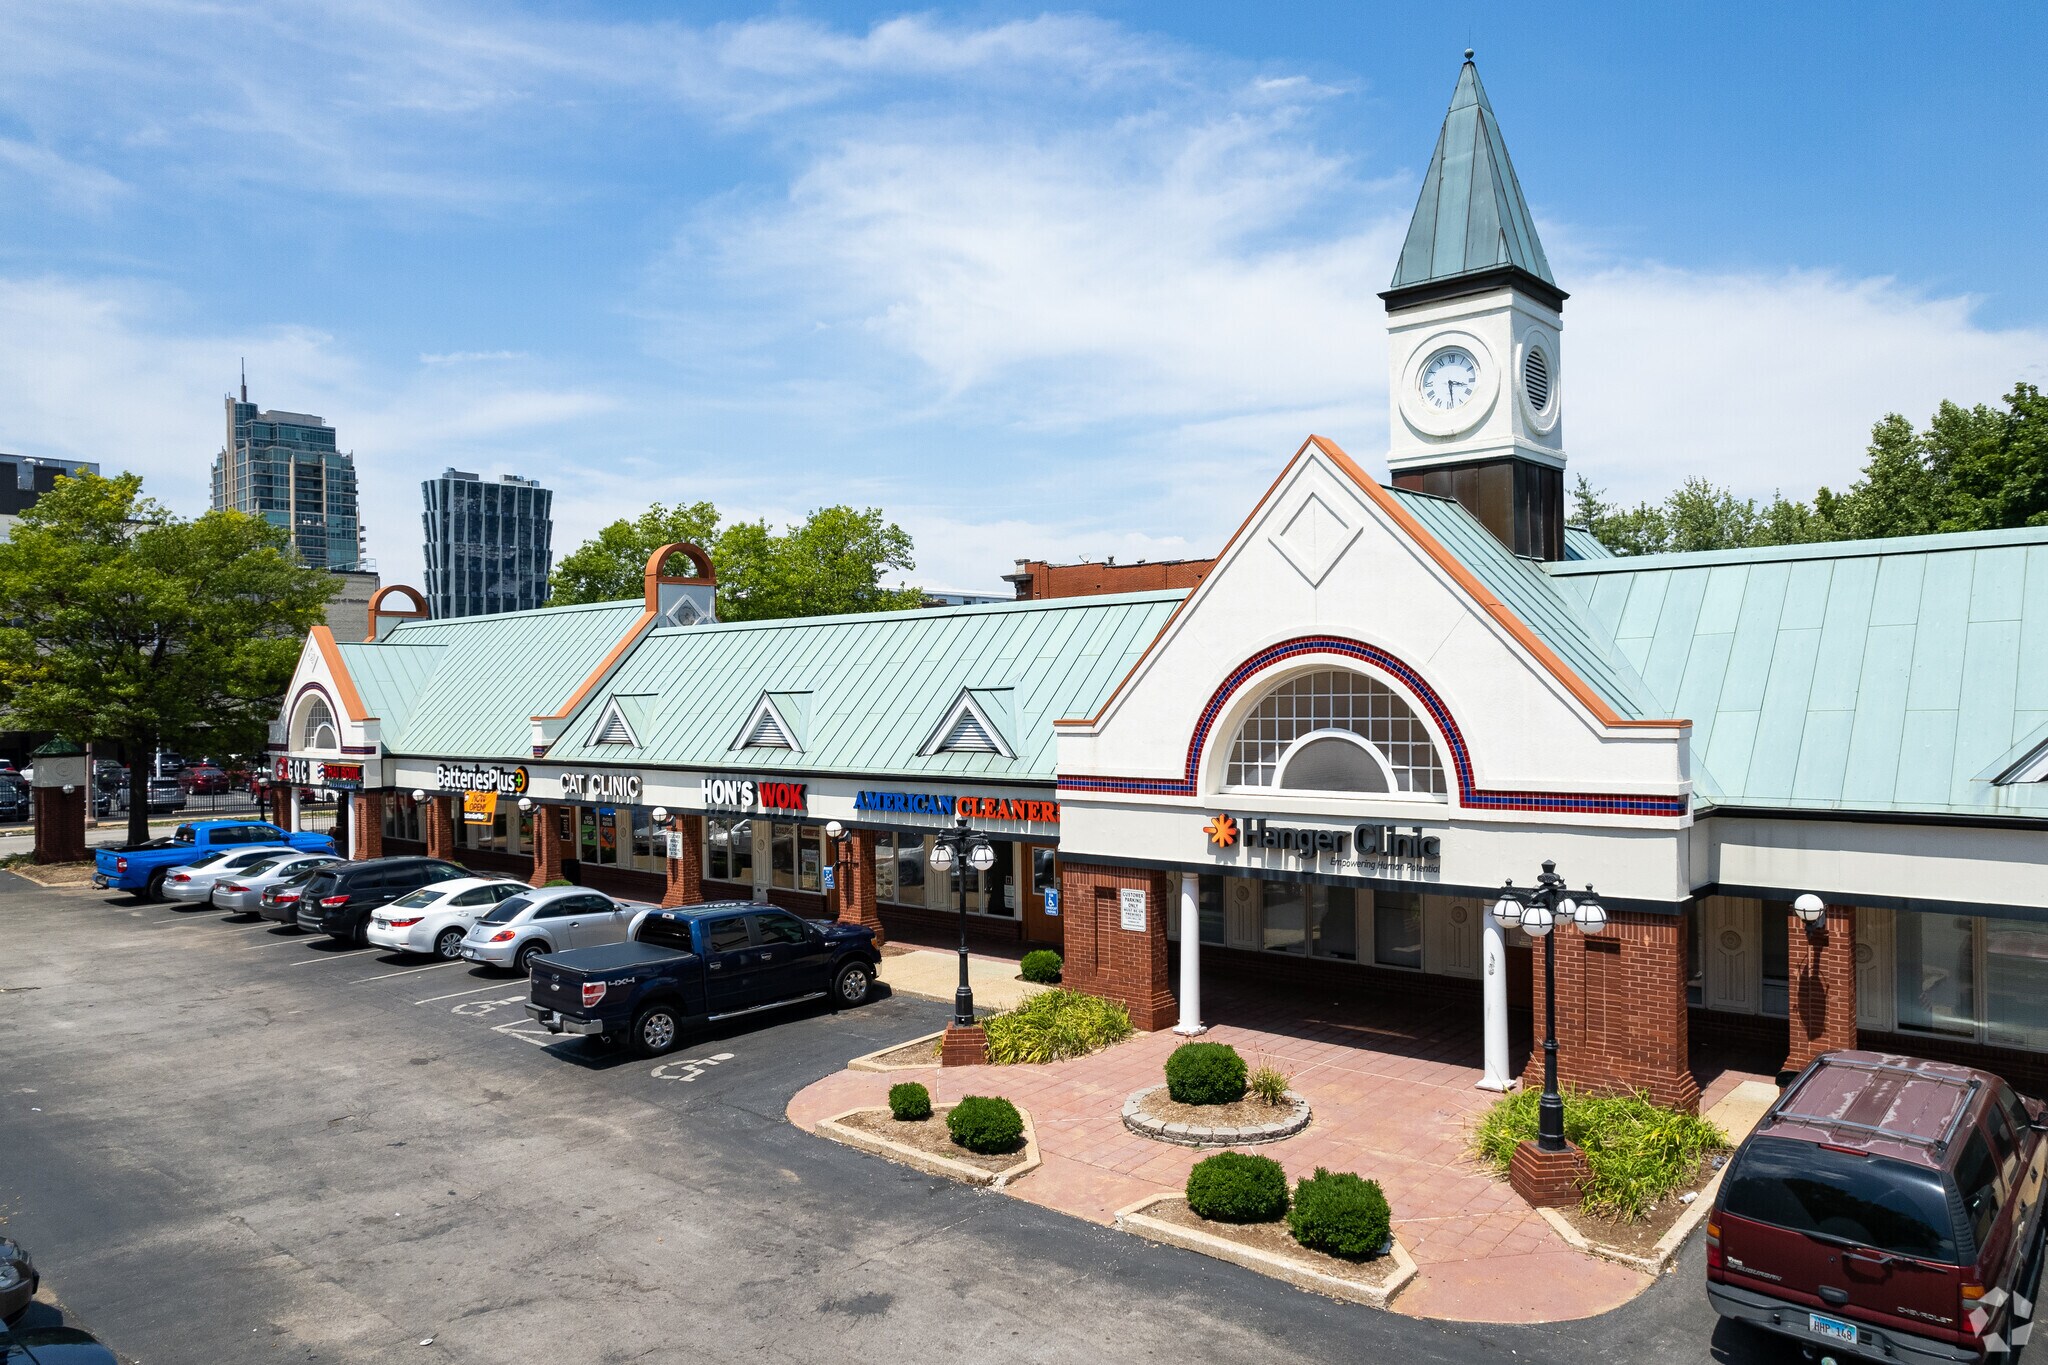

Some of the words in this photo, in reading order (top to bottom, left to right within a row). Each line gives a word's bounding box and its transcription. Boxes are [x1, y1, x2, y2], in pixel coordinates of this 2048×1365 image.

[560, 773, 585, 794] CAT
[591, 774, 640, 798] CLINIC
[701, 779, 754, 807] HON'S
[758, 781, 803, 811] WOK
[853, 790, 954, 816] AMERICAN
[956, 796, 1060, 823] CLEANER
[1243, 817, 1350, 860] Hanger
[1354, 823, 1440, 860] Clinic
[1330, 857, 1376, 871] Empowering
[1377, 860, 1404, 872] Human
[1407, 862, 1441, 874] Potential
[1897, 1306, 1953, 1324] CHEVROLET
[1814, 1320, 1831, 1334] HHP
[1836, 1327, 1853, 1342] 148
